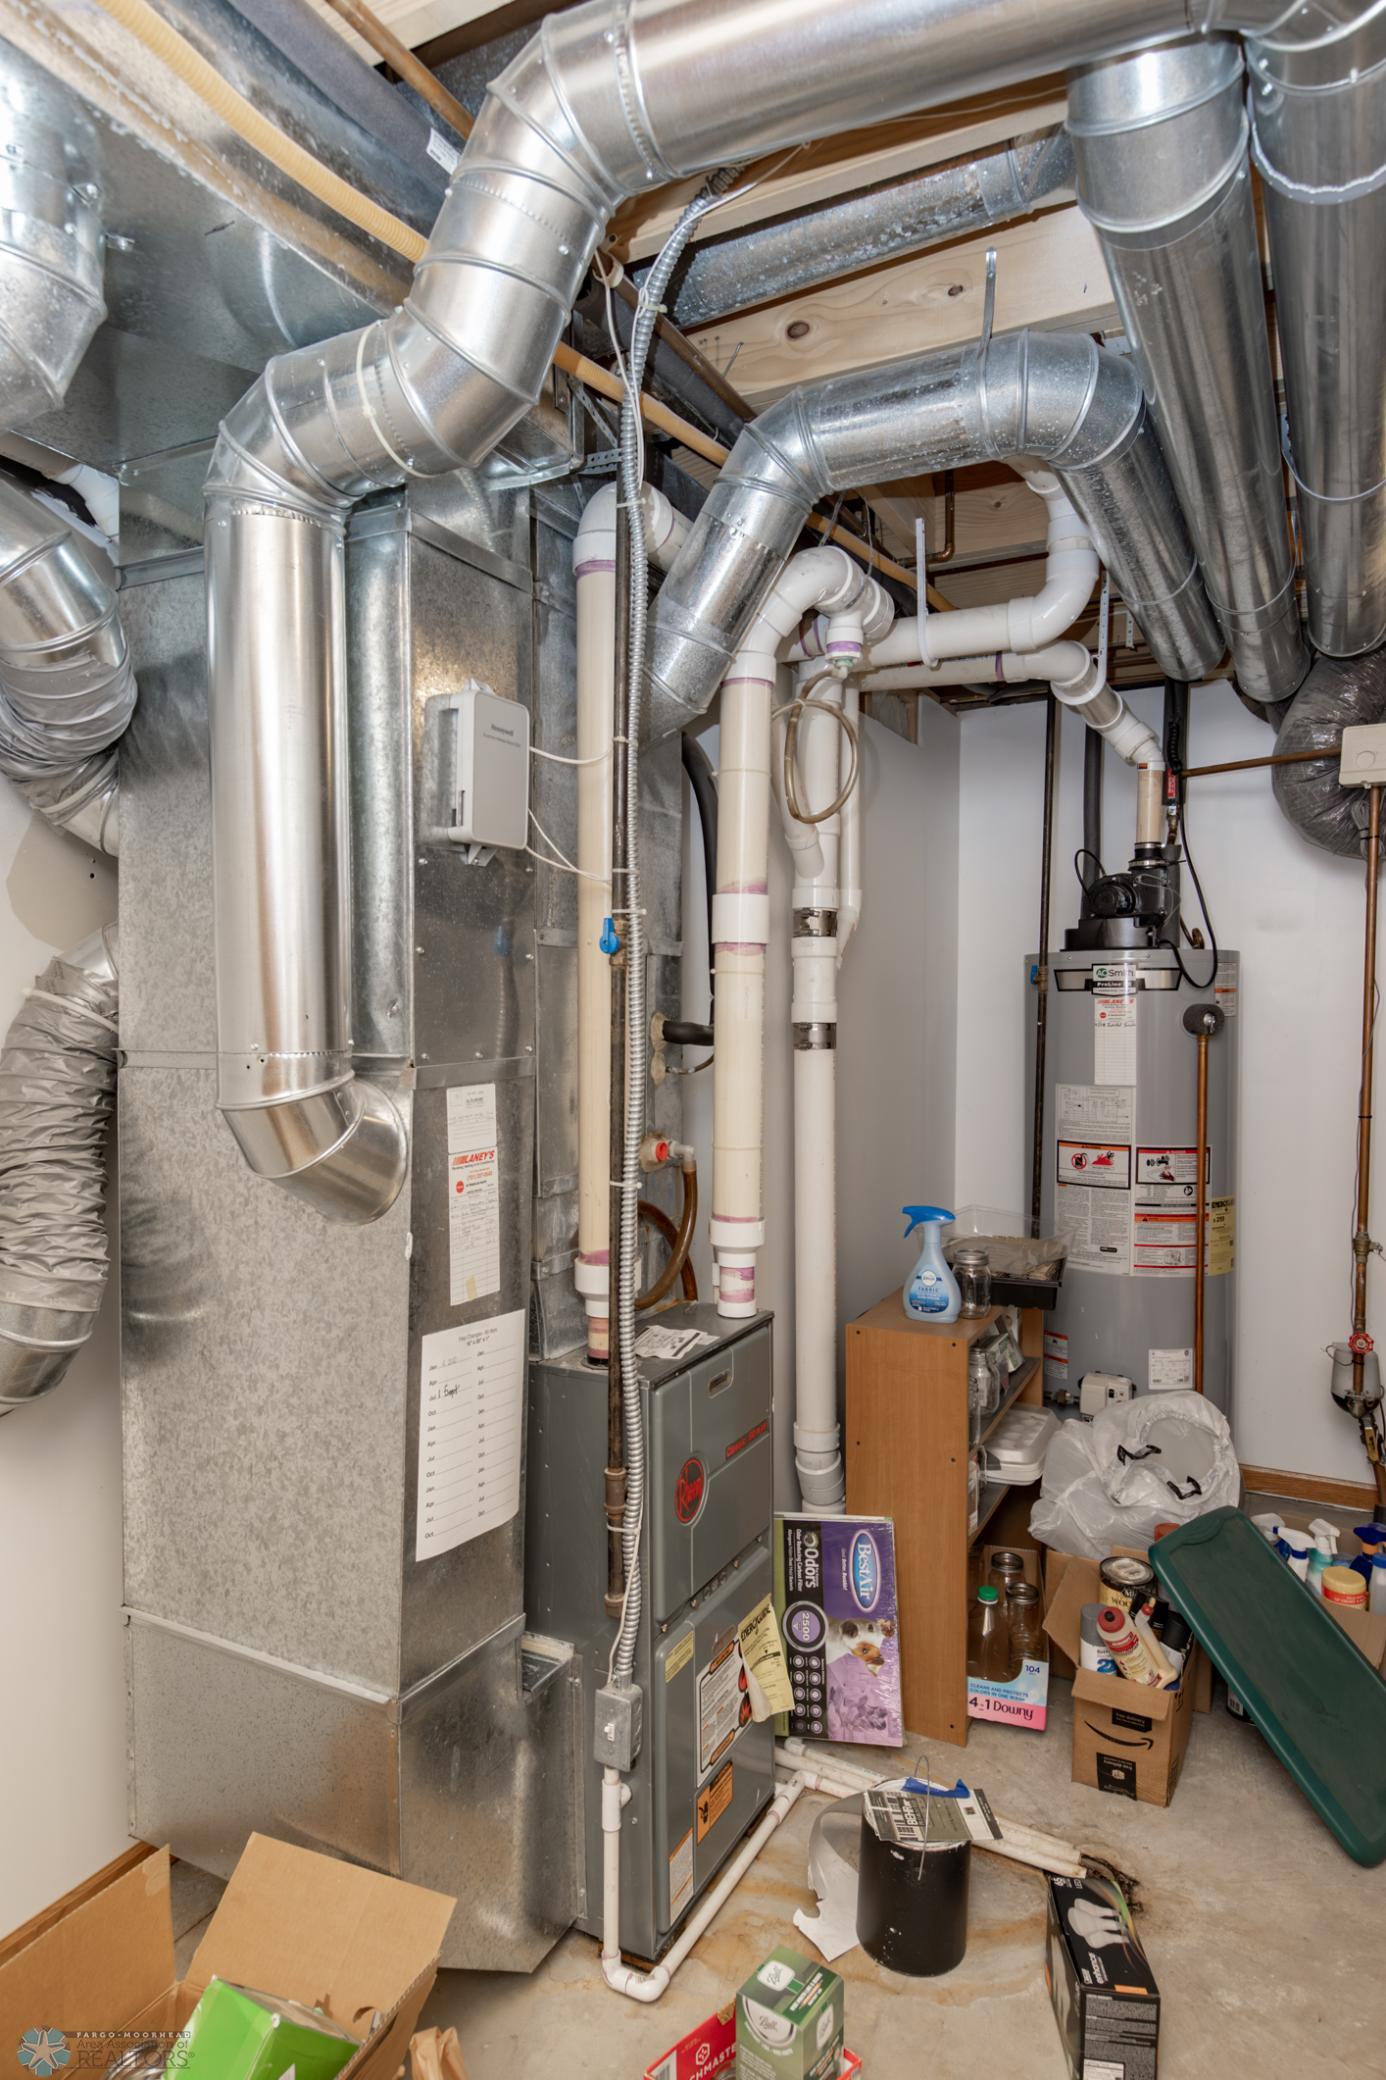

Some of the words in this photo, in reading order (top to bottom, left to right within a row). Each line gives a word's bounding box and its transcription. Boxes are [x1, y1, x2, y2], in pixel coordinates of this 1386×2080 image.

[1109, 969, 1133, 977] Smih
[804, 1548, 819, 1588] Odors
[857, 1543, 873, 1600] BestAir
[802, 1612, 810, 1640] 2500
[1025, 1665, 1040, 1674] 104
[969, 1696, 978, 1707] 4
[993, 1700, 1034, 1720] Downy
[903, 1806, 918, 1825] BEHR
